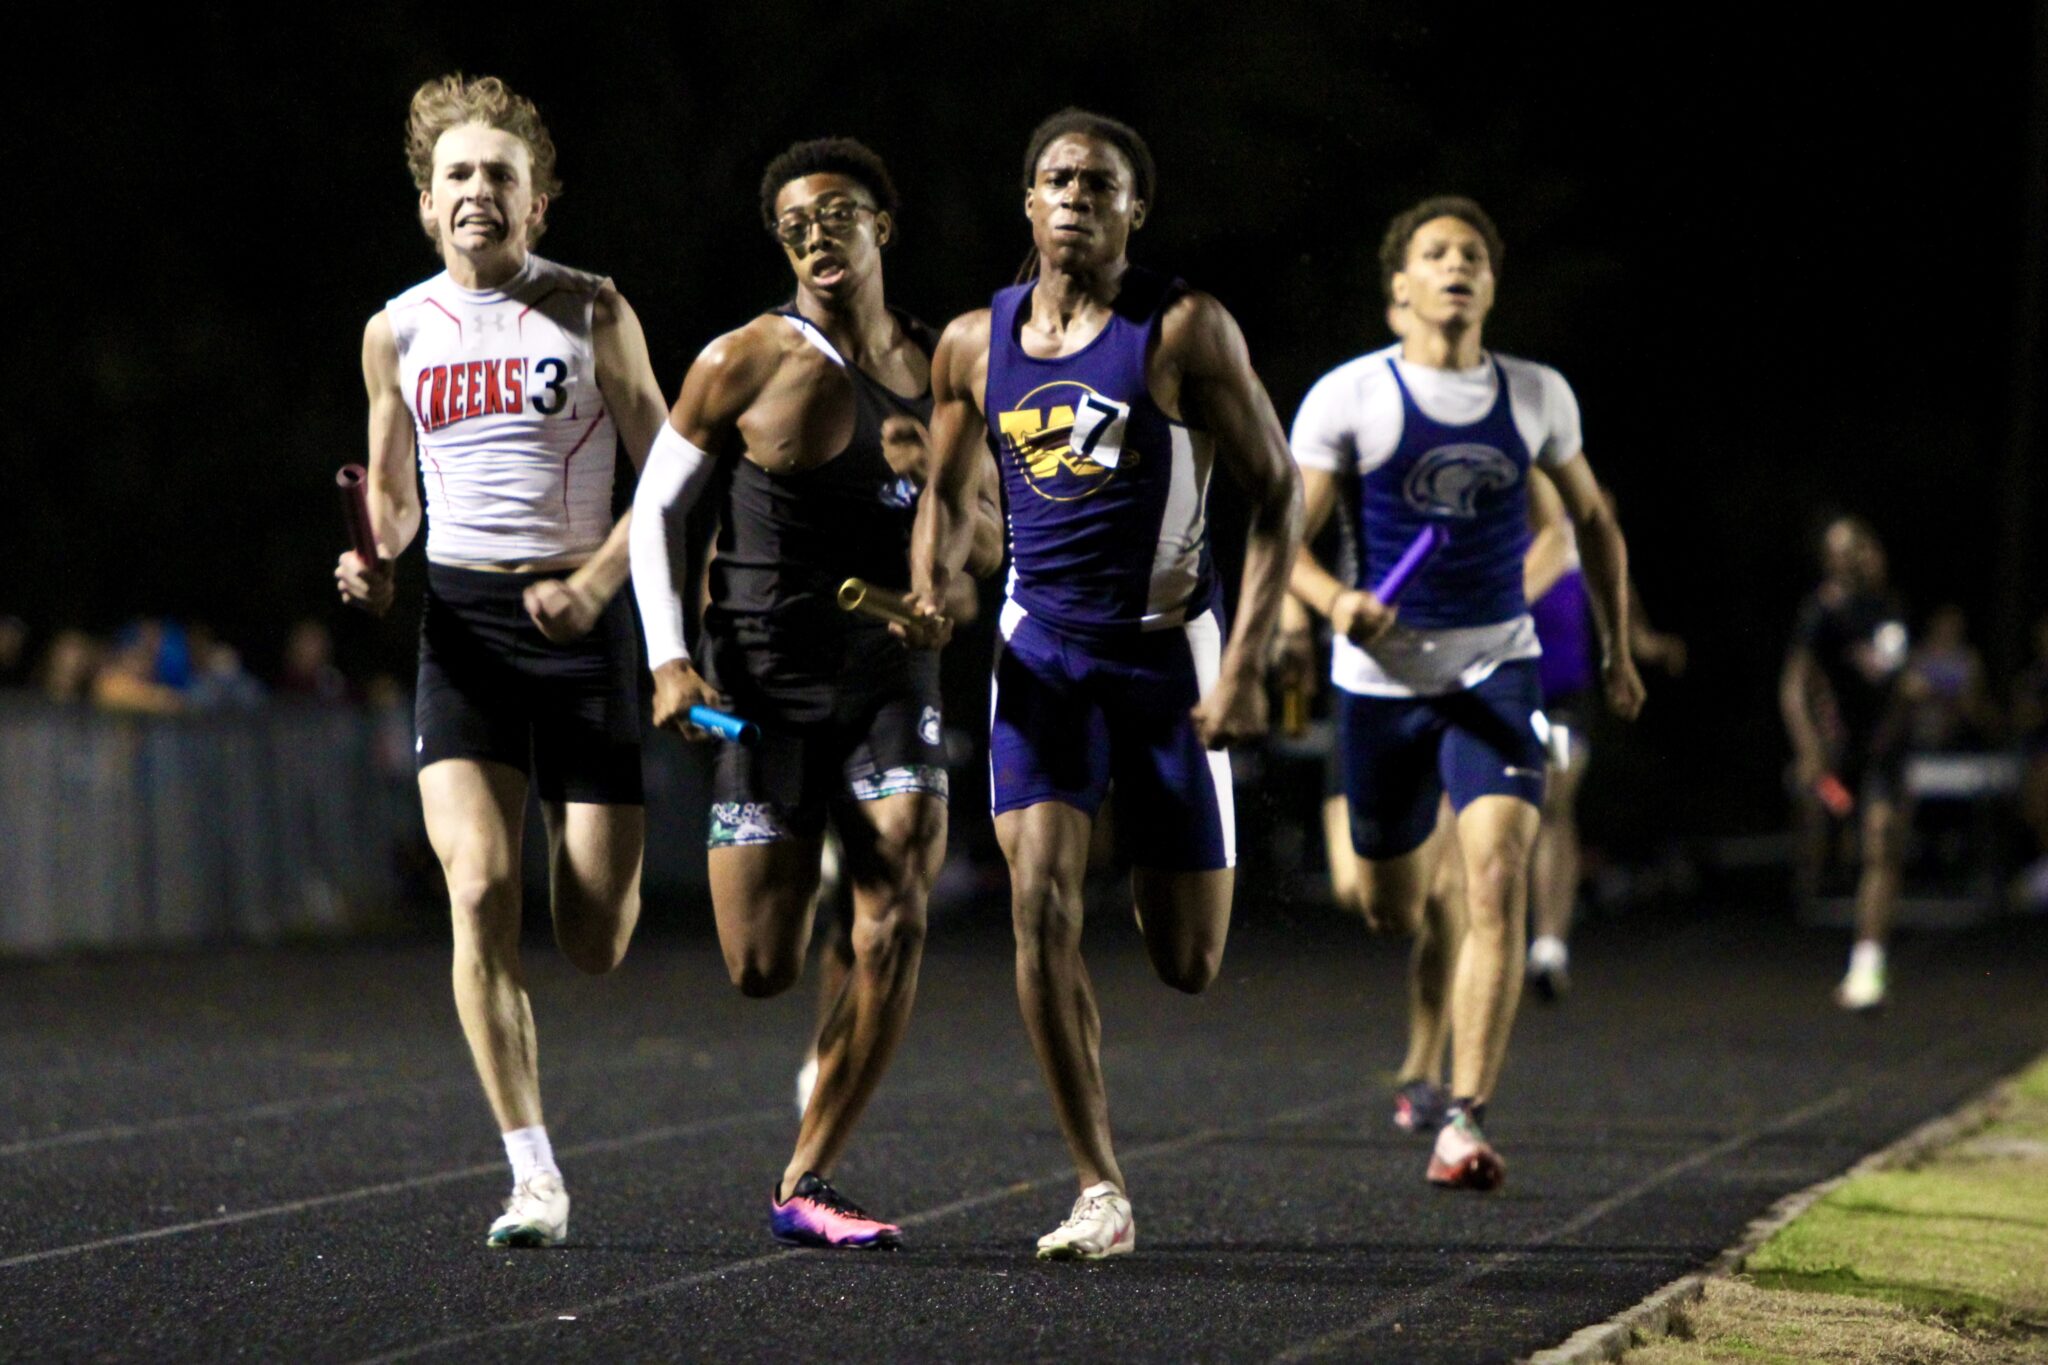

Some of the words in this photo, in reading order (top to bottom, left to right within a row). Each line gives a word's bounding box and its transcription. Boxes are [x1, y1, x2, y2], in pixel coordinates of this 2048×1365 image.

[416, 358, 529, 433] CREEKS
[532, 358, 568, 416] 3
[1081, 396, 1120, 456] 7
